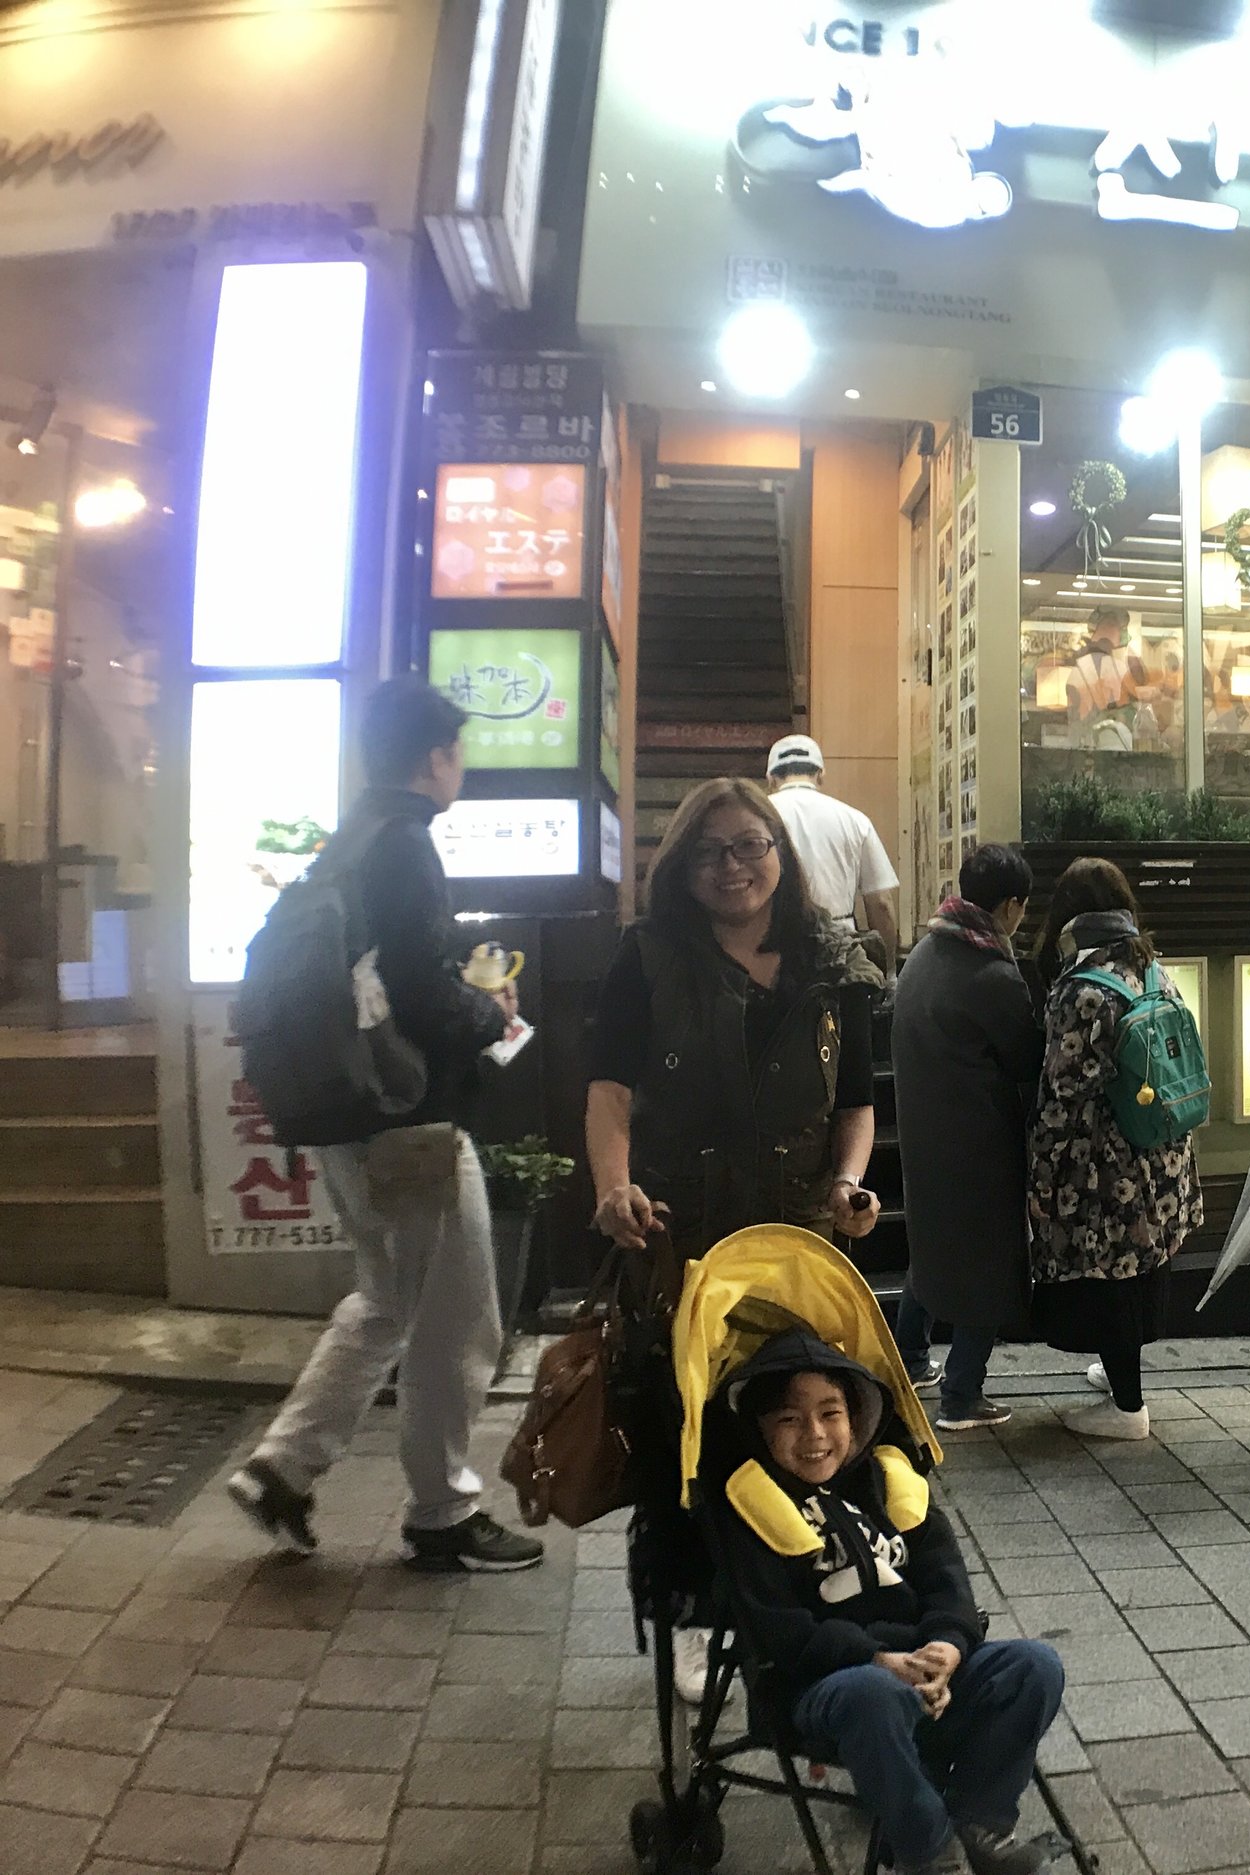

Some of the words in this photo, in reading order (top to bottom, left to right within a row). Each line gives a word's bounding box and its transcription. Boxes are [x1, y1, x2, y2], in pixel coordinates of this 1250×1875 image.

[990, 413, 1020, 436] 56
[484, 528, 573, 555] エステ
